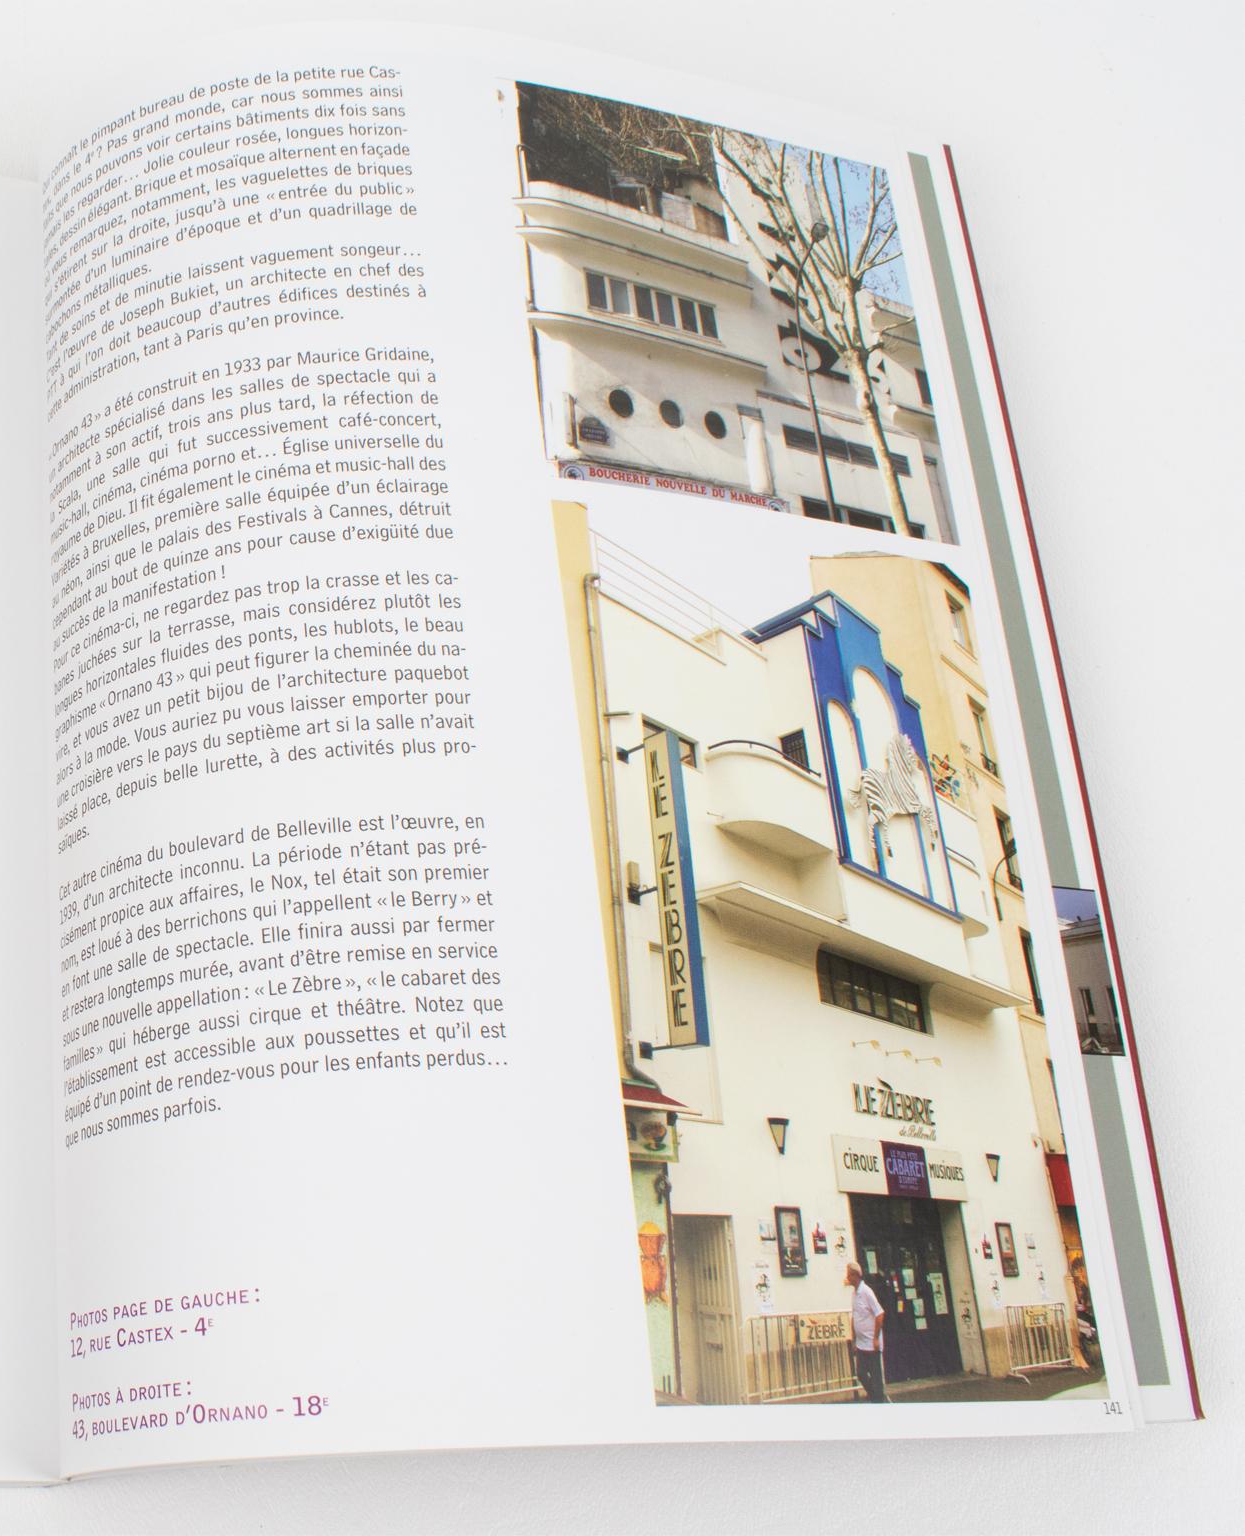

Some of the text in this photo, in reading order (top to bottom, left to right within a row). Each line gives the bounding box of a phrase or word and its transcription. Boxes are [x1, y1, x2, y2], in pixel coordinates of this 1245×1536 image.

[210, 65, 400, 100] poste de la petite rue Cas-
[302, 84, 402, 100] sommes ainsi
[237, 103, 405, 128] bâtiments dix fois sans
[349, 123, 407, 136] horizon-
[242, 162, 412, 188] vaguelettes de briques
[309, 202, 416, 220] quadrillage de
[188, 244, 333, 280] laissent vaguement
[251, 262, 424, 287] architecte en chef des
[279, 283, 410, 304] édifices destinés
[275, 307, 343, 328] province.
[225, 347, 434, 377] 1933 par Maurice Gridaine,
[240, 368, 420, 396] salles de spectacle qui
[241, 390, 438, 420] plus tard, la réfection de
[207, 412, 441, 446] successivement café-concert,
[283, 433, 443, 457] Église universelle du
[255, 455, 446, 481] cinéma et music-hall des
[268, 478, 448, 503] équipée éclairage
[589, 467, 650, 485] BOUCHERIE
[656, 478, 706, 496] NOUVELLE
[712, 487, 725, 498] DU
[238, 500, 451, 530] Festivals à Cannes, détruit
[248, 524, 453, 554] pour cause due
[267, 569, 458, 595] trop la crasse et les ca-
[289, 593, 461, 616] considérez plutôt les
[249, 616, 463, 648] ponts, les hublots, le beau
[255, 640, 466, 669] figurer la cheminée du na-
[395, 664, 469, 684] paquebot
[291, 690, 470, 712] laisser emporter pour
[227, 713, 414, 746] septième art salle
[325, 738, 476, 758] activités plus pro-
[169, 815, 384, 857] boulevard de Belleville est
[279, 838, 486, 867] période pas pré-
[314, 863, 489, 886] tel était son premier
[649, 749, 689, 1028] LE ZEBRE
[298, 915, 494, 940] finira aussi par fermer
[348, 941, 497, 963] remise en service
[402, 968, 500, 987] cabaret des
[416, 996, 503, 1015] Notez que
[305, 1023, 426, 1050] poussettes et
[281, 1050, 420, 1079] pour les enfants
[164, 1095, 221, 1123] parfois.
[843, 1147, 880, 1173] CIRQUE
[885, 1158, 925, 1178] CABARET
[928, 1160, 965, 1181] MUSIQUES
[70, 1336, 87, 1359] 12,
[1103, 1401, 1123, 1415] 141
[71, 1418, 90, 1441] 43,
